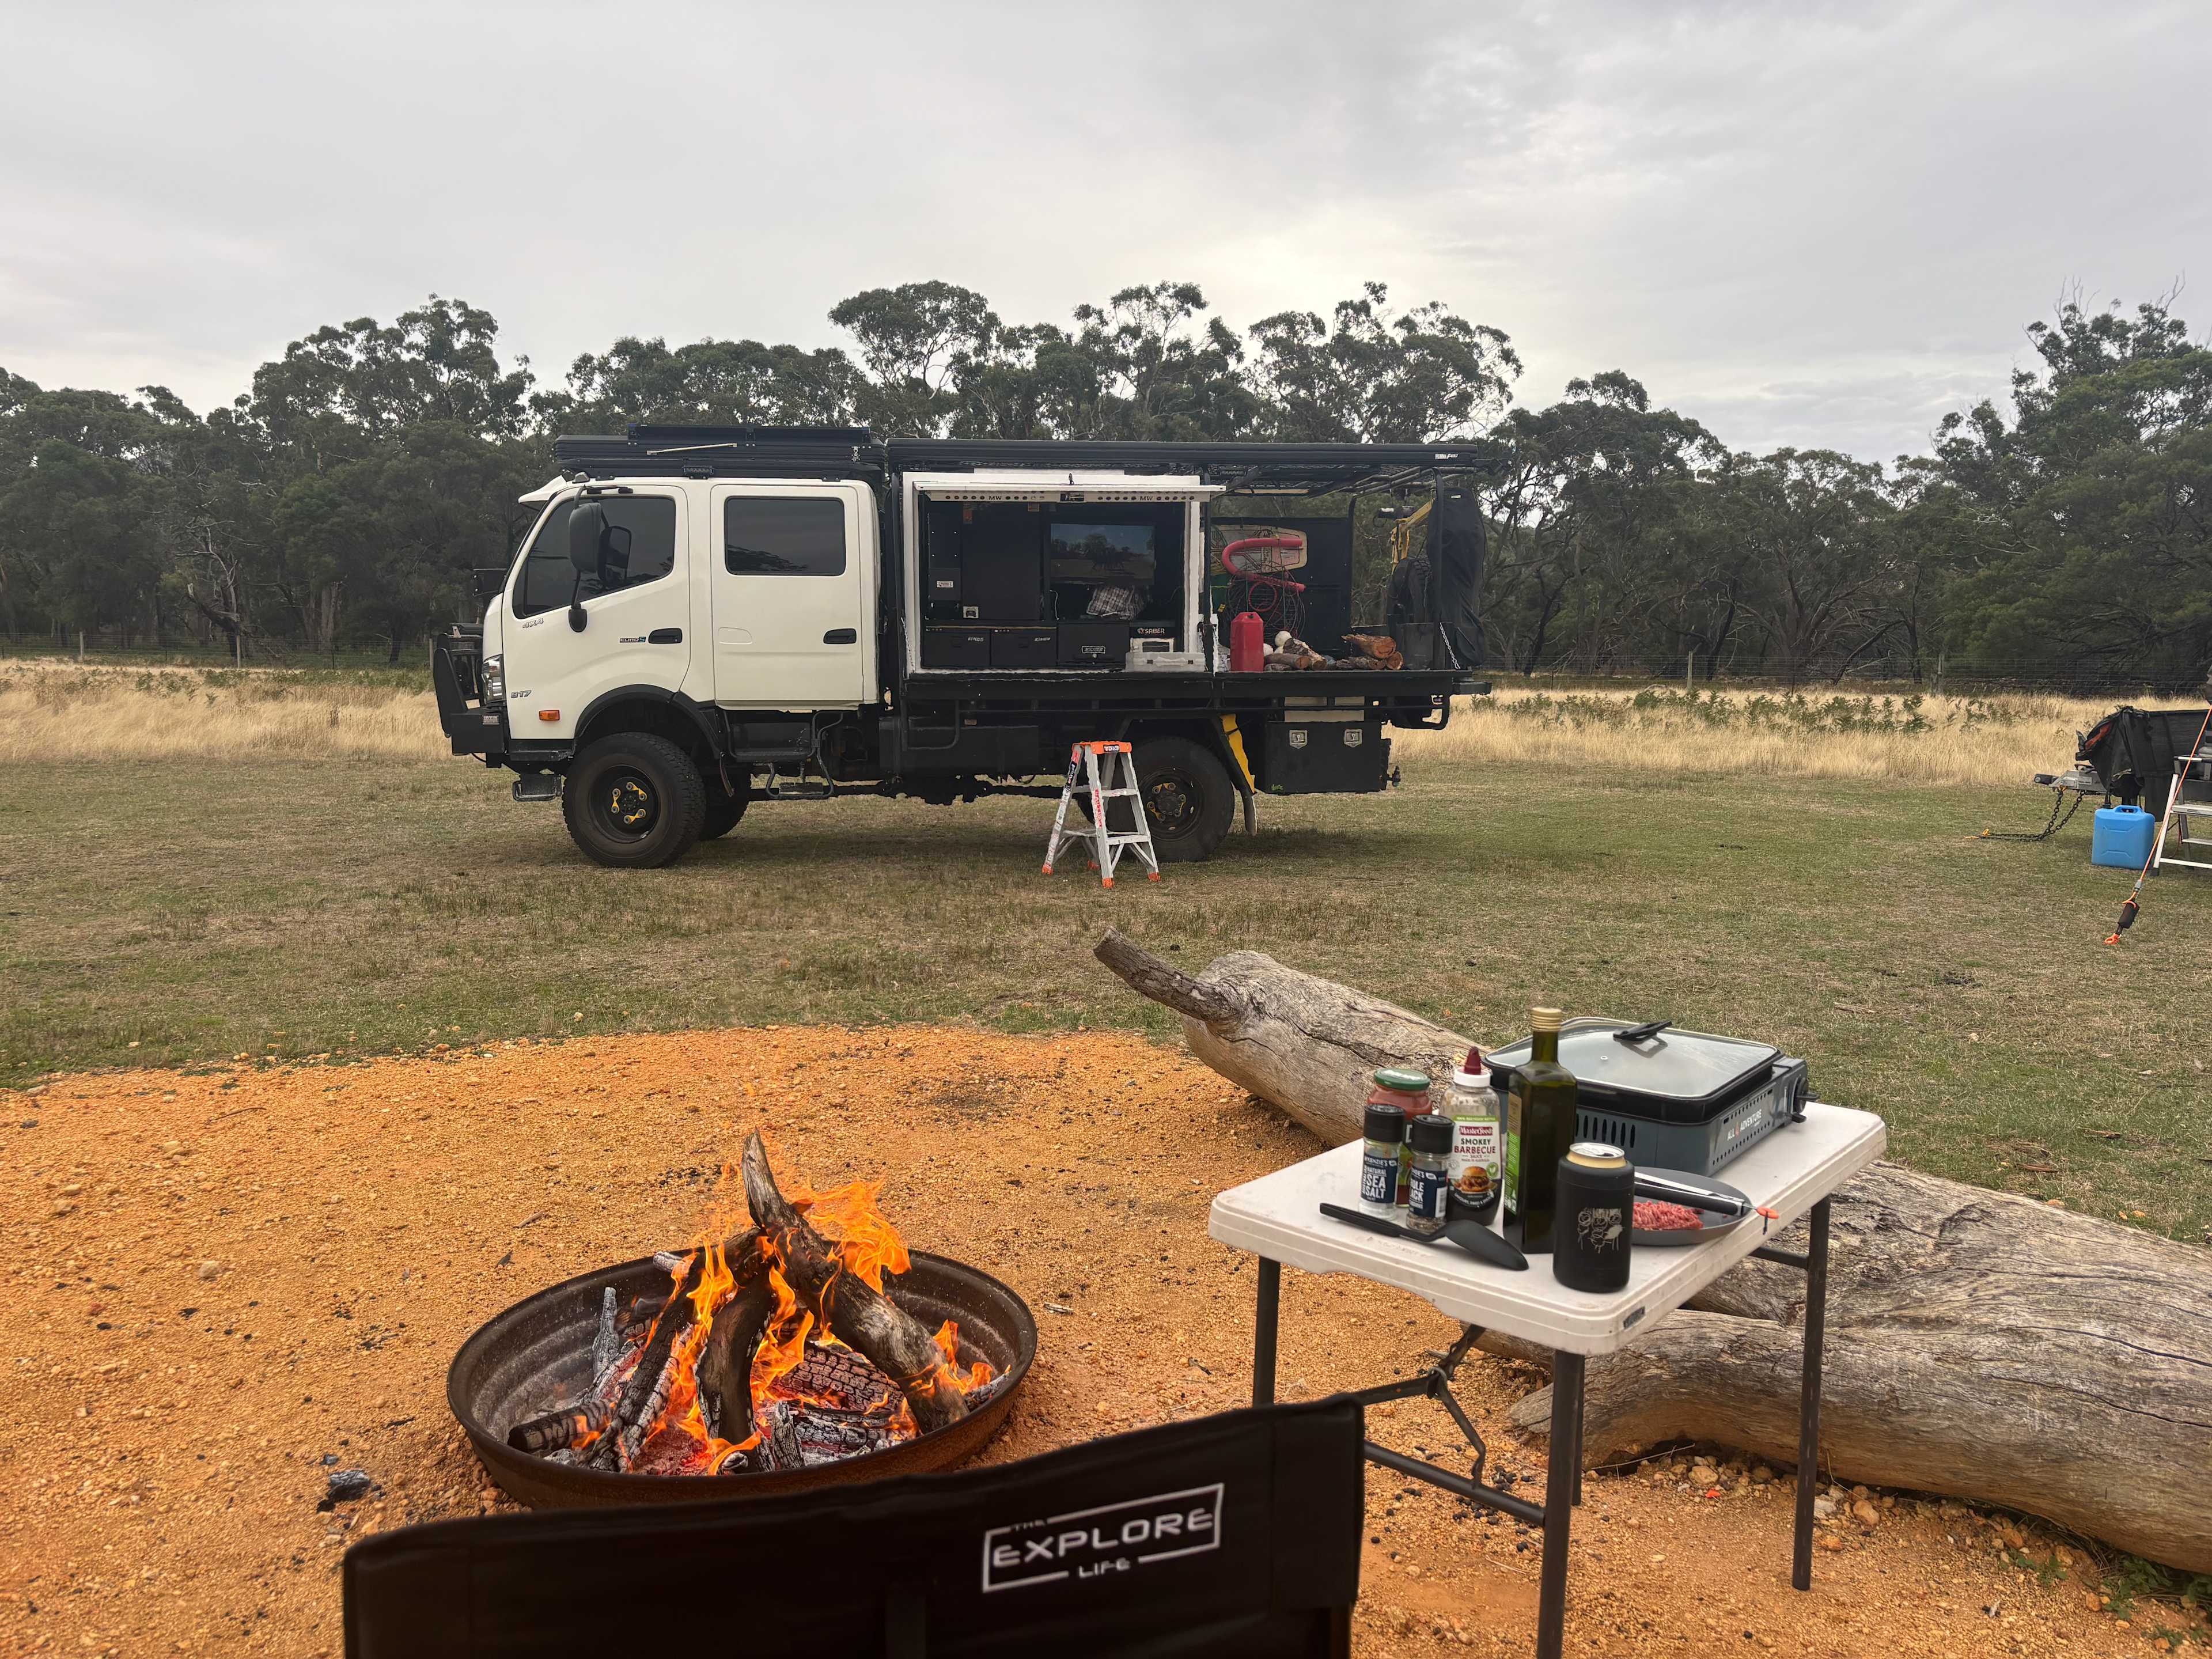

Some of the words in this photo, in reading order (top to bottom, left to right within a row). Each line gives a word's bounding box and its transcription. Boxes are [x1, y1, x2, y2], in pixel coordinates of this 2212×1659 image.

[511, 690, 532, 698] 917
[1454, 1145, 1496, 1154] BARBECUE
[1366, 1174, 1386, 1188] SEA
[1365, 1185, 1386, 1199] SALT
[993, 1508, 1213, 1567] EXPLORE
[1079, 1558, 1130, 1578] LIFE
